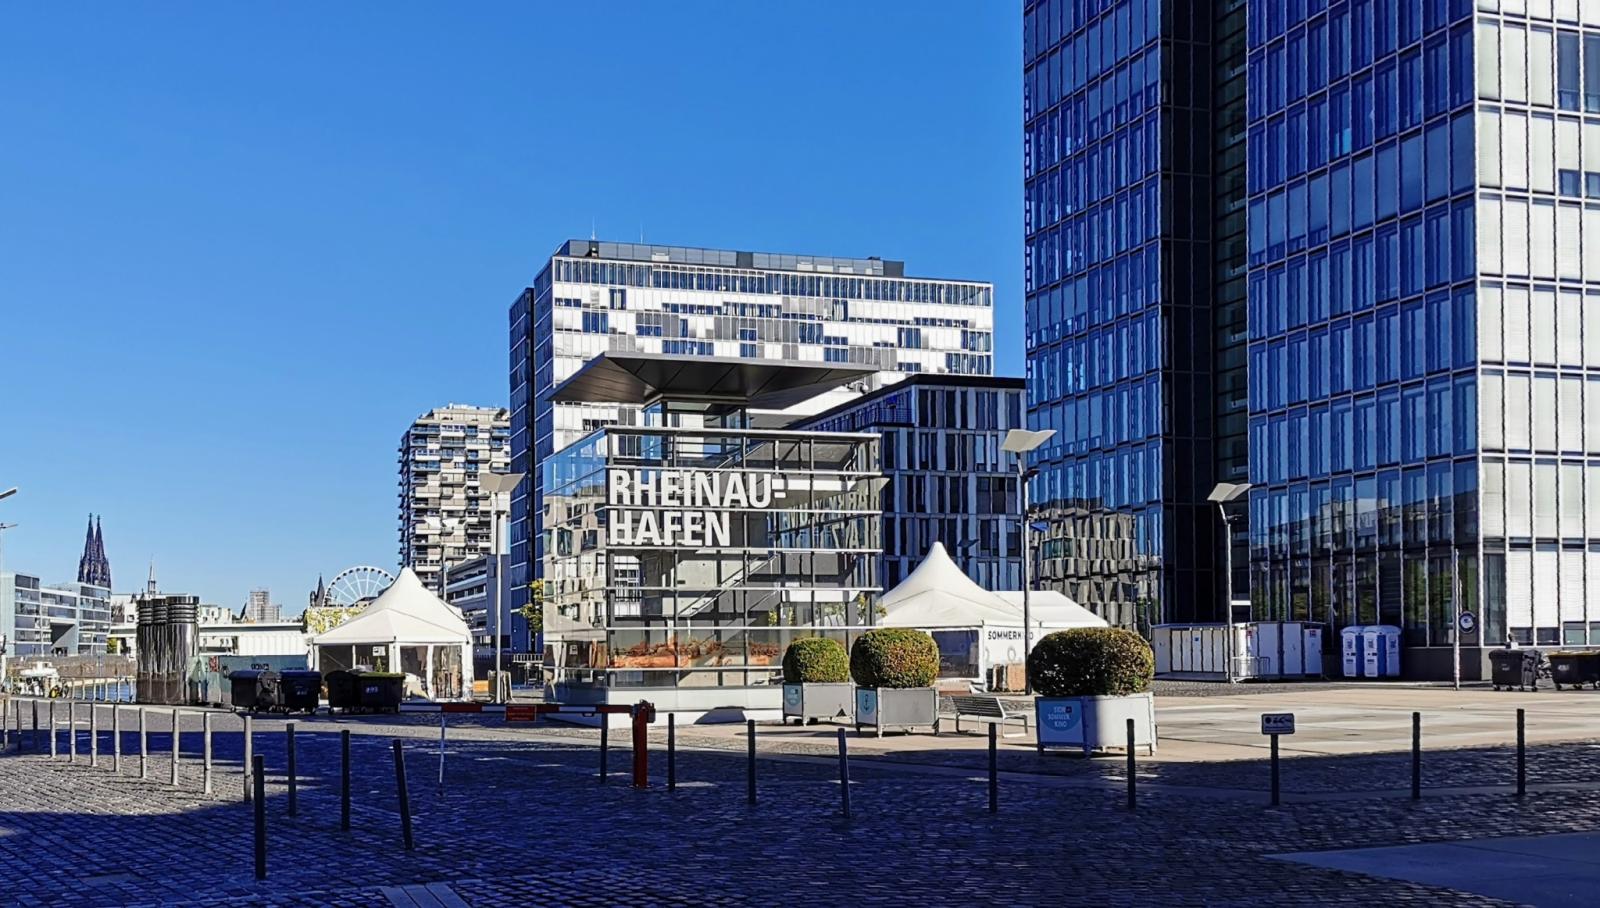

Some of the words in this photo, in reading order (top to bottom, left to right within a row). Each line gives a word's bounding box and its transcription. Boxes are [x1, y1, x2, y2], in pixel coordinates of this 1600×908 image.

[609, 469, 786, 508] RHEINAU-
[609, 510, 731, 547] HAFEN
[988, 630, 1034, 640] SOMMERKO
